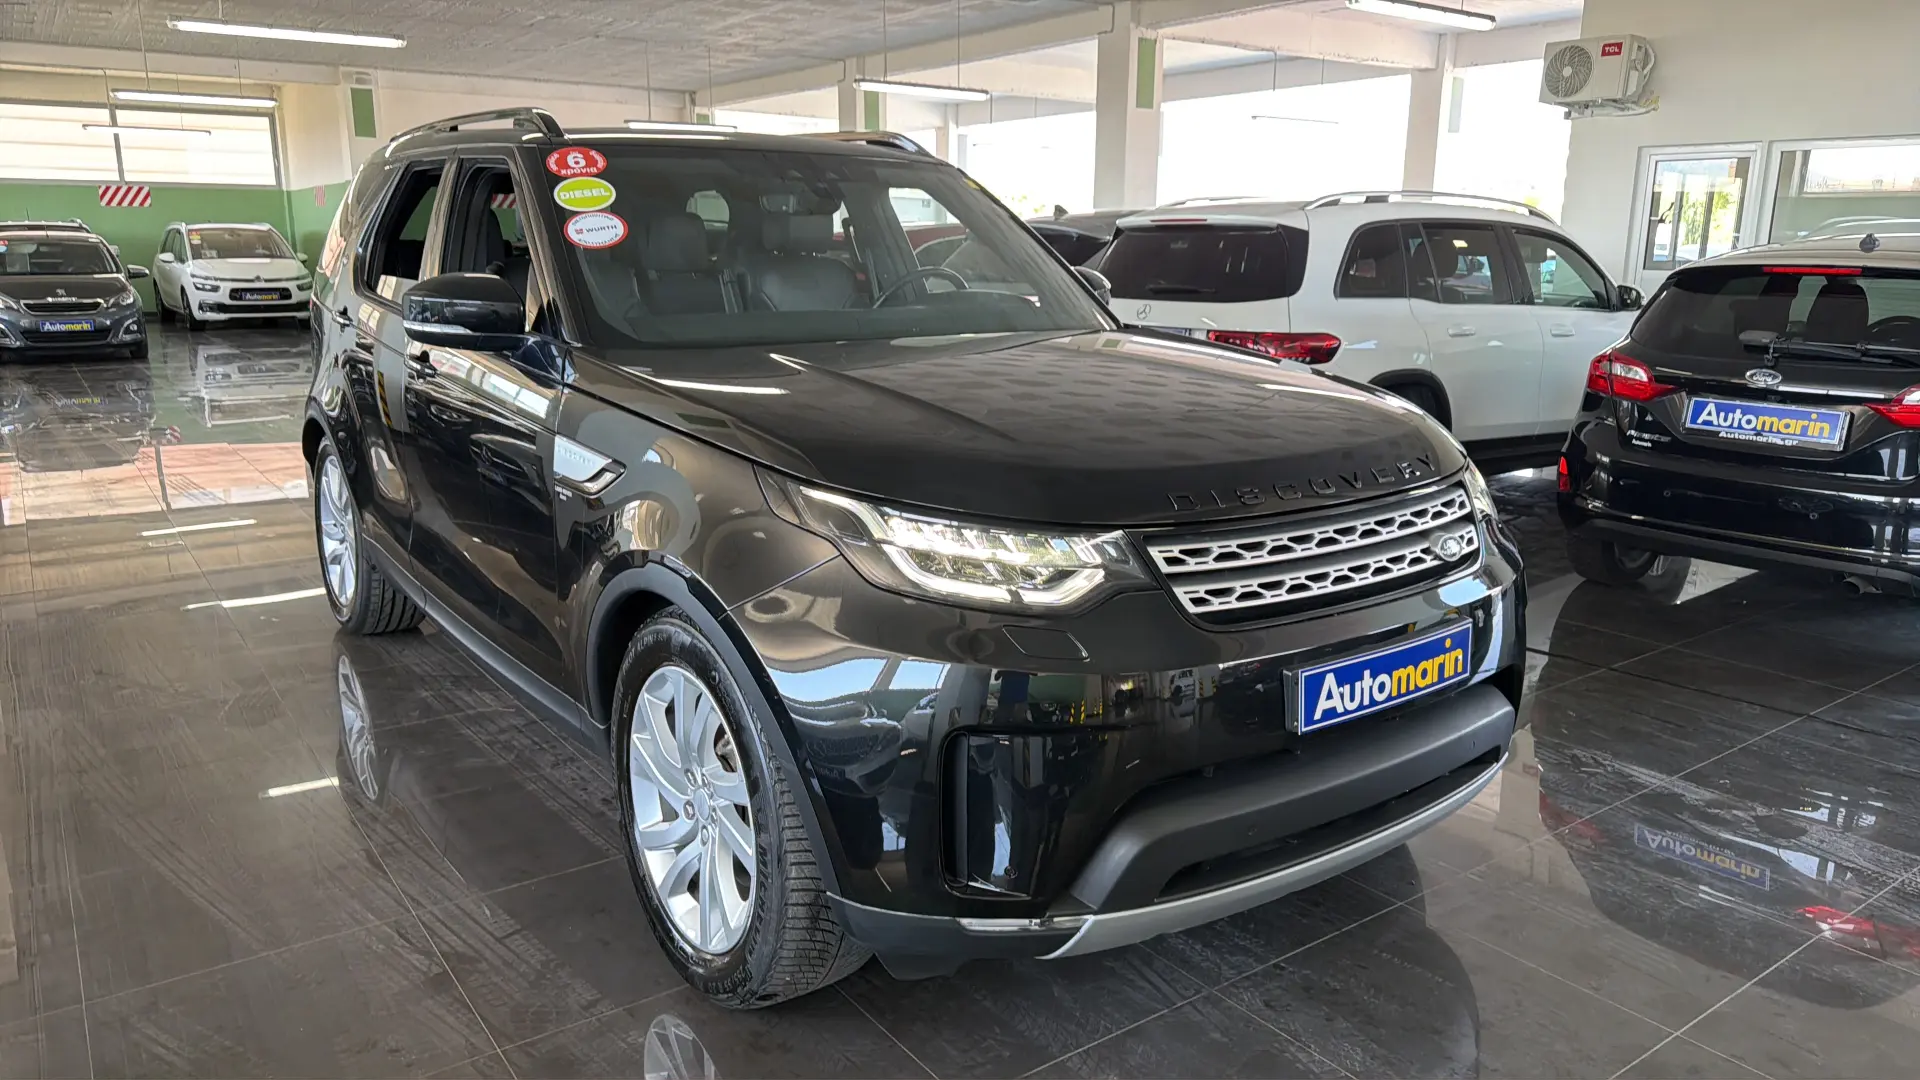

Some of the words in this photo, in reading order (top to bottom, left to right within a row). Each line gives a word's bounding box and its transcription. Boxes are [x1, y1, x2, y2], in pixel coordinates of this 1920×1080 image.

[566, 153, 587, 169] 6
[560, 166, 598, 175] χρόνια
[560, 188, 610, 200] DIESEL
[43, 321, 91, 331] Automarin
[1697, 402, 1830, 437] Automarin
[1166, 451, 1436, 511] DISCOVERY
[1313, 637, 1463, 721] Automarin
